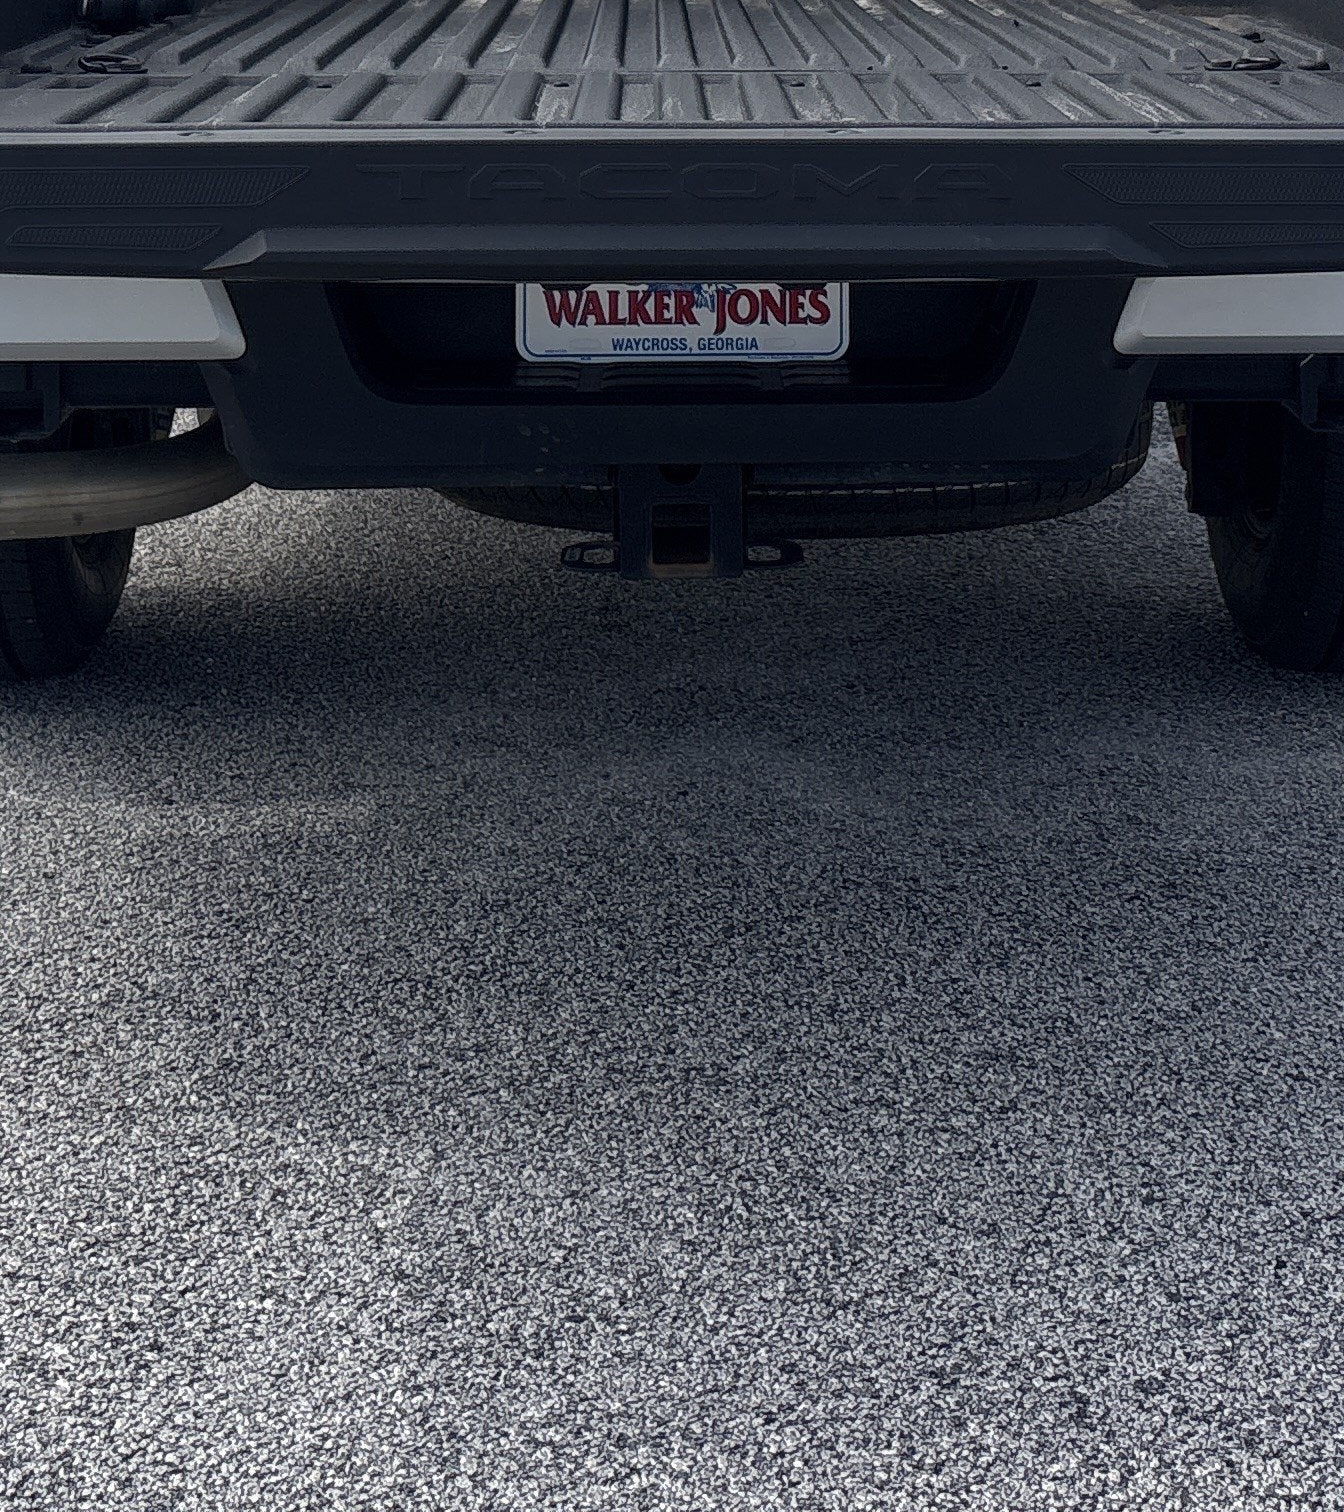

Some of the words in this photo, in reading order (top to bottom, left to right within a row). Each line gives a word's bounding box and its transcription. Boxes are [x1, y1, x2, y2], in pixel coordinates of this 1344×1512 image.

[354, 163, 1014, 201] TACOMA
[543, 289, 700, 327] WALKER
[713, 287, 831, 335] JONES
[612, 337, 693, 353] WAYCROSS,
[698, 337, 758, 351] GEORGIA
